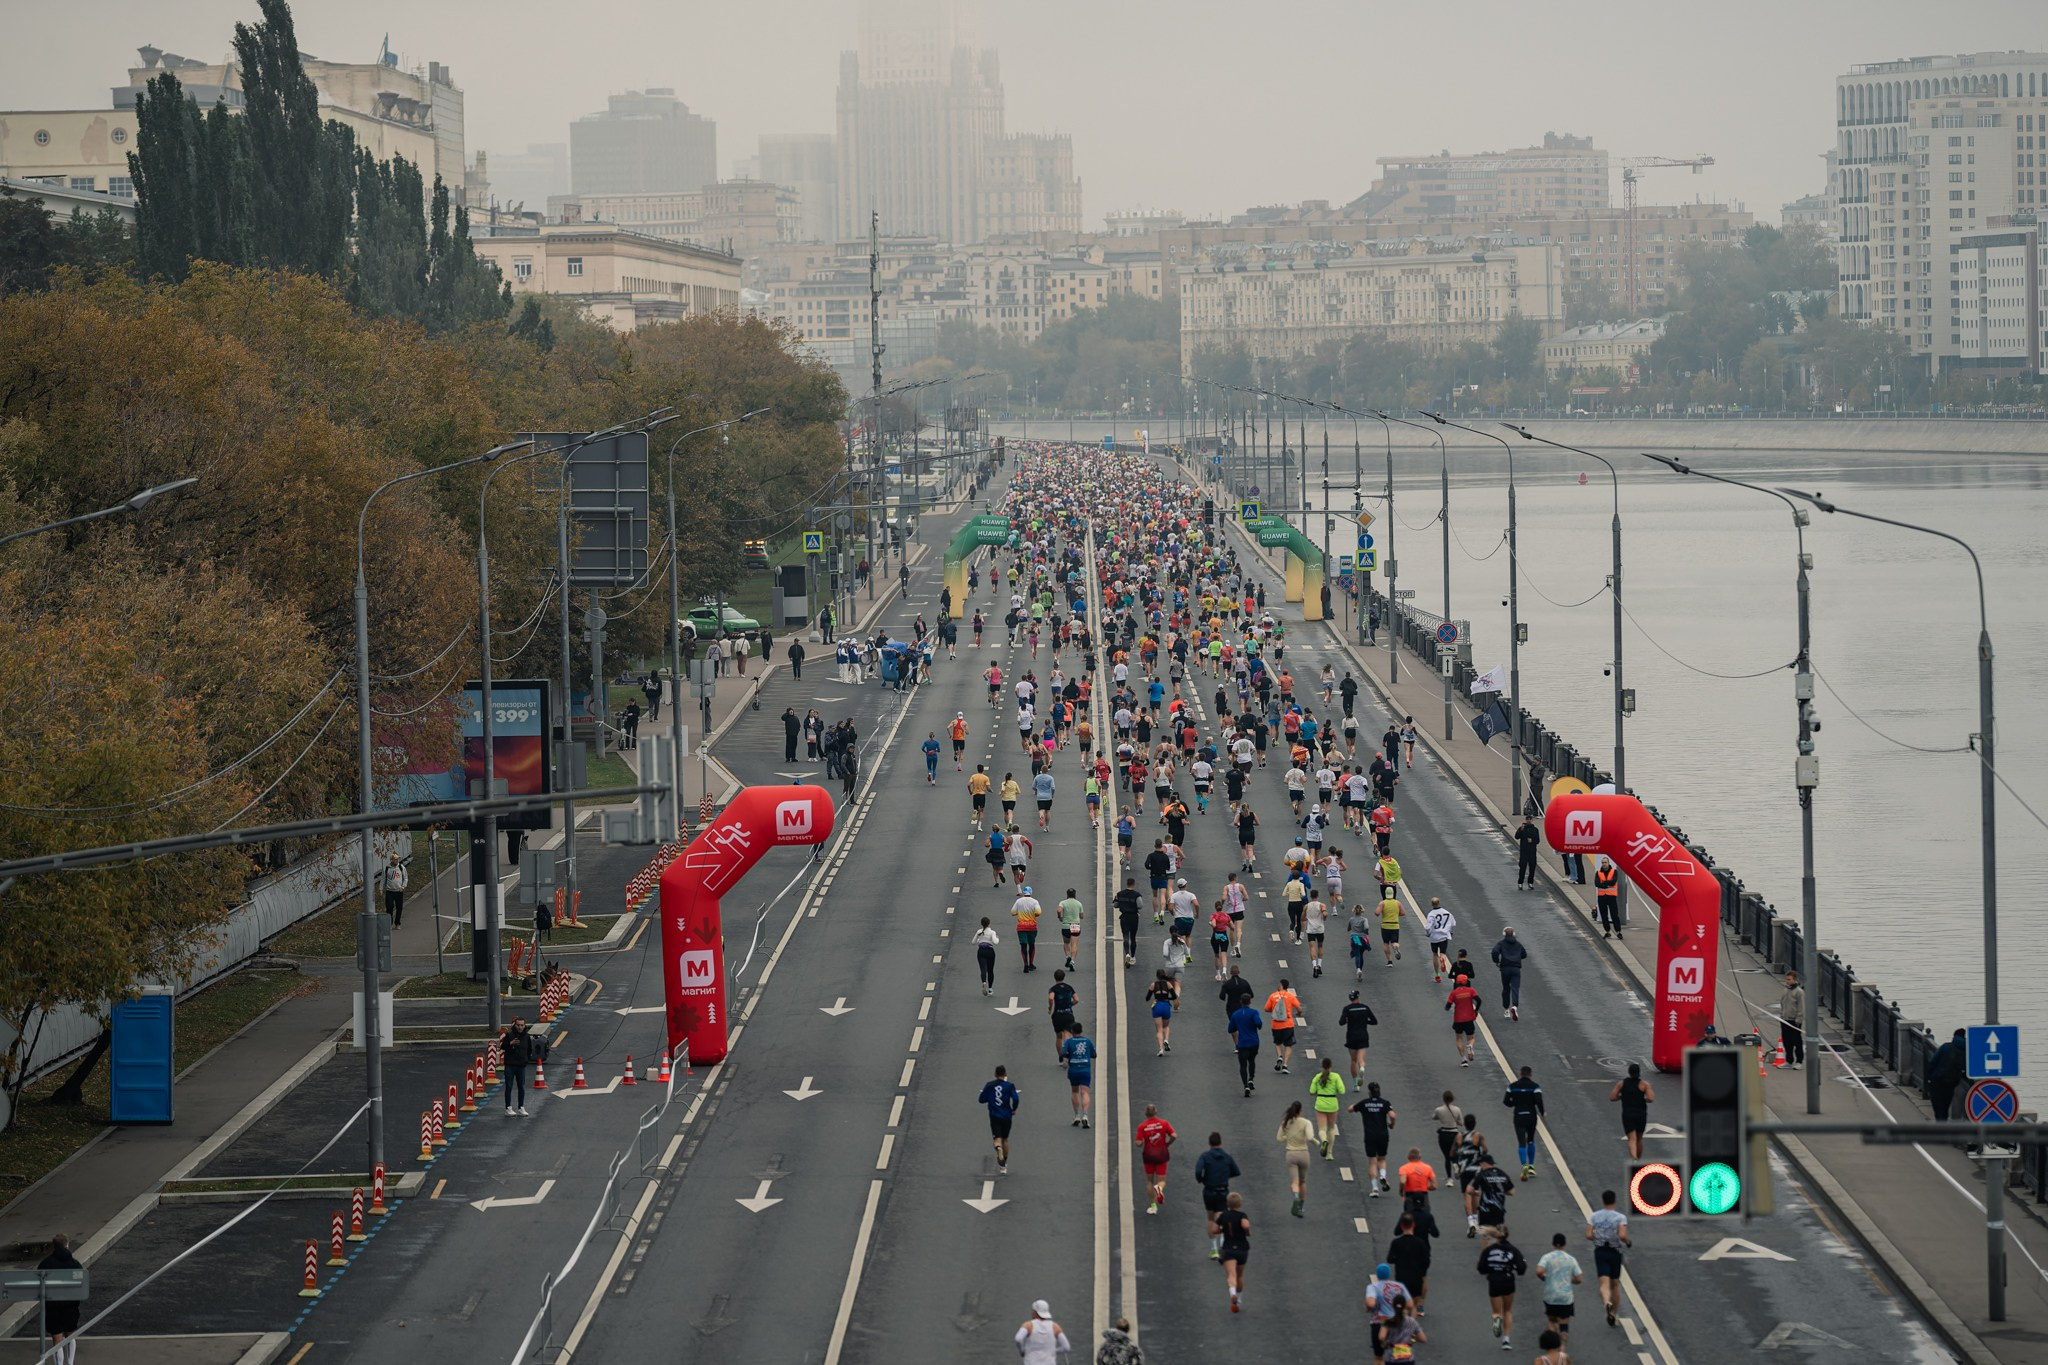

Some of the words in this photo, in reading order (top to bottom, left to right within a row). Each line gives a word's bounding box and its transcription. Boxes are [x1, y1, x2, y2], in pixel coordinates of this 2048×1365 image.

[1261, 532, 1290, 540] HUAWEI
[495, 709, 529, 723] 399
[783, 809, 805, 826] М
[1573, 820, 1594, 836] М
[1434, 913, 1450, 929] 37
[687, 960, 709, 977] М
[1675, 967, 1697, 984] М
